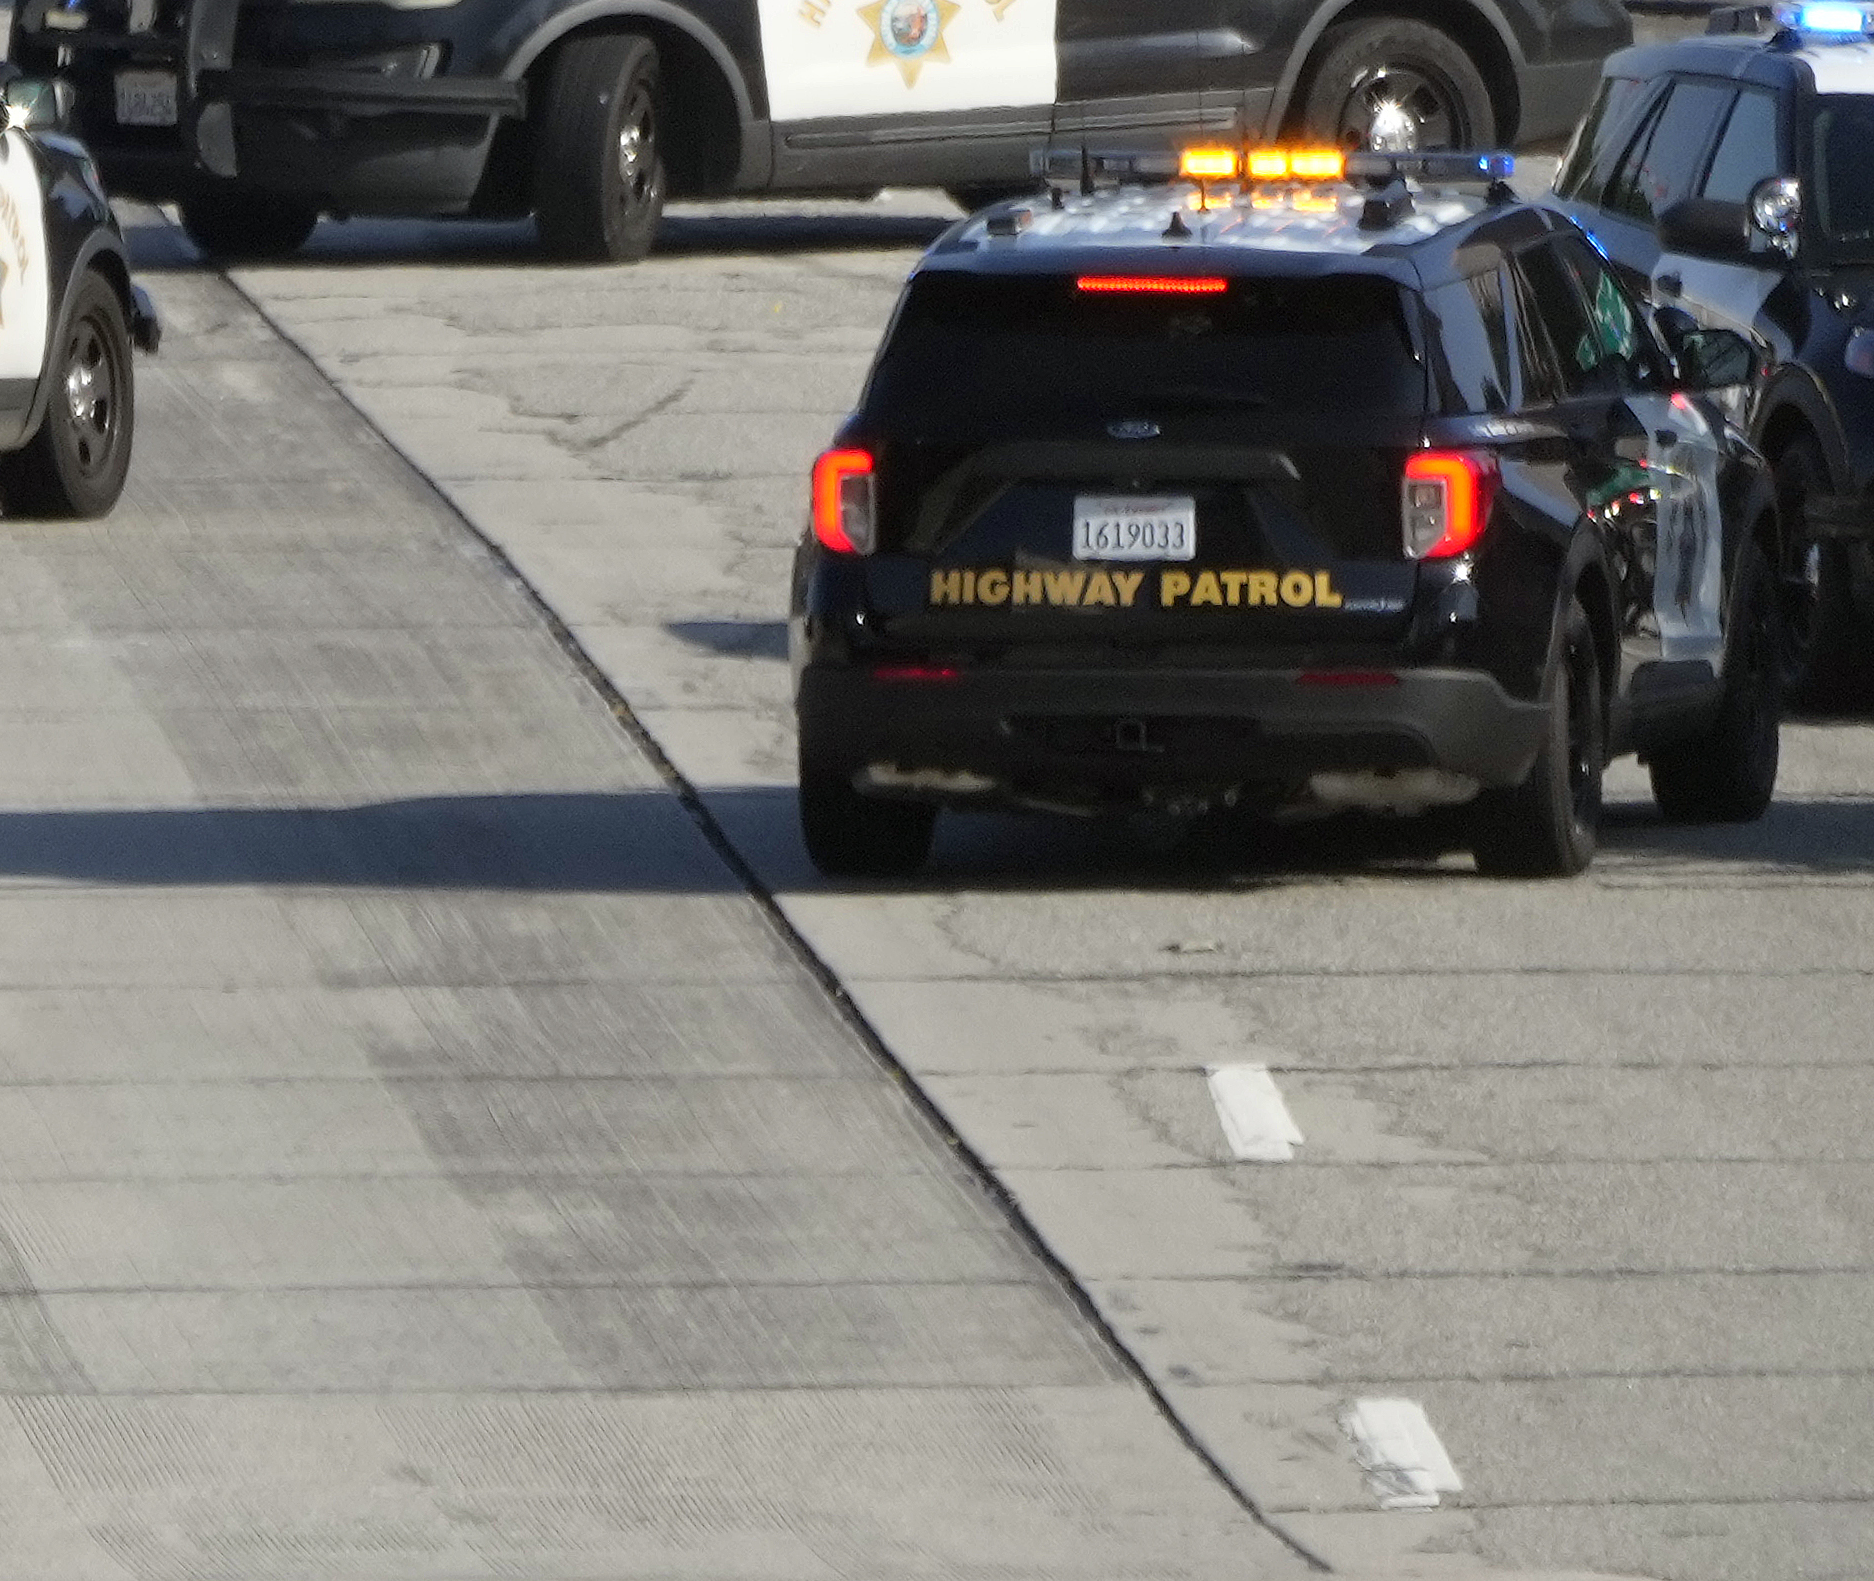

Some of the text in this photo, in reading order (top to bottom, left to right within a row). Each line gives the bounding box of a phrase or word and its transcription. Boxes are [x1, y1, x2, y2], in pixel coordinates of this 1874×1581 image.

[1081, 519, 1186, 551] 1619033
[929, 569, 1146, 607] HIGHWAY
[1160, 569, 1343, 608] PATROL
